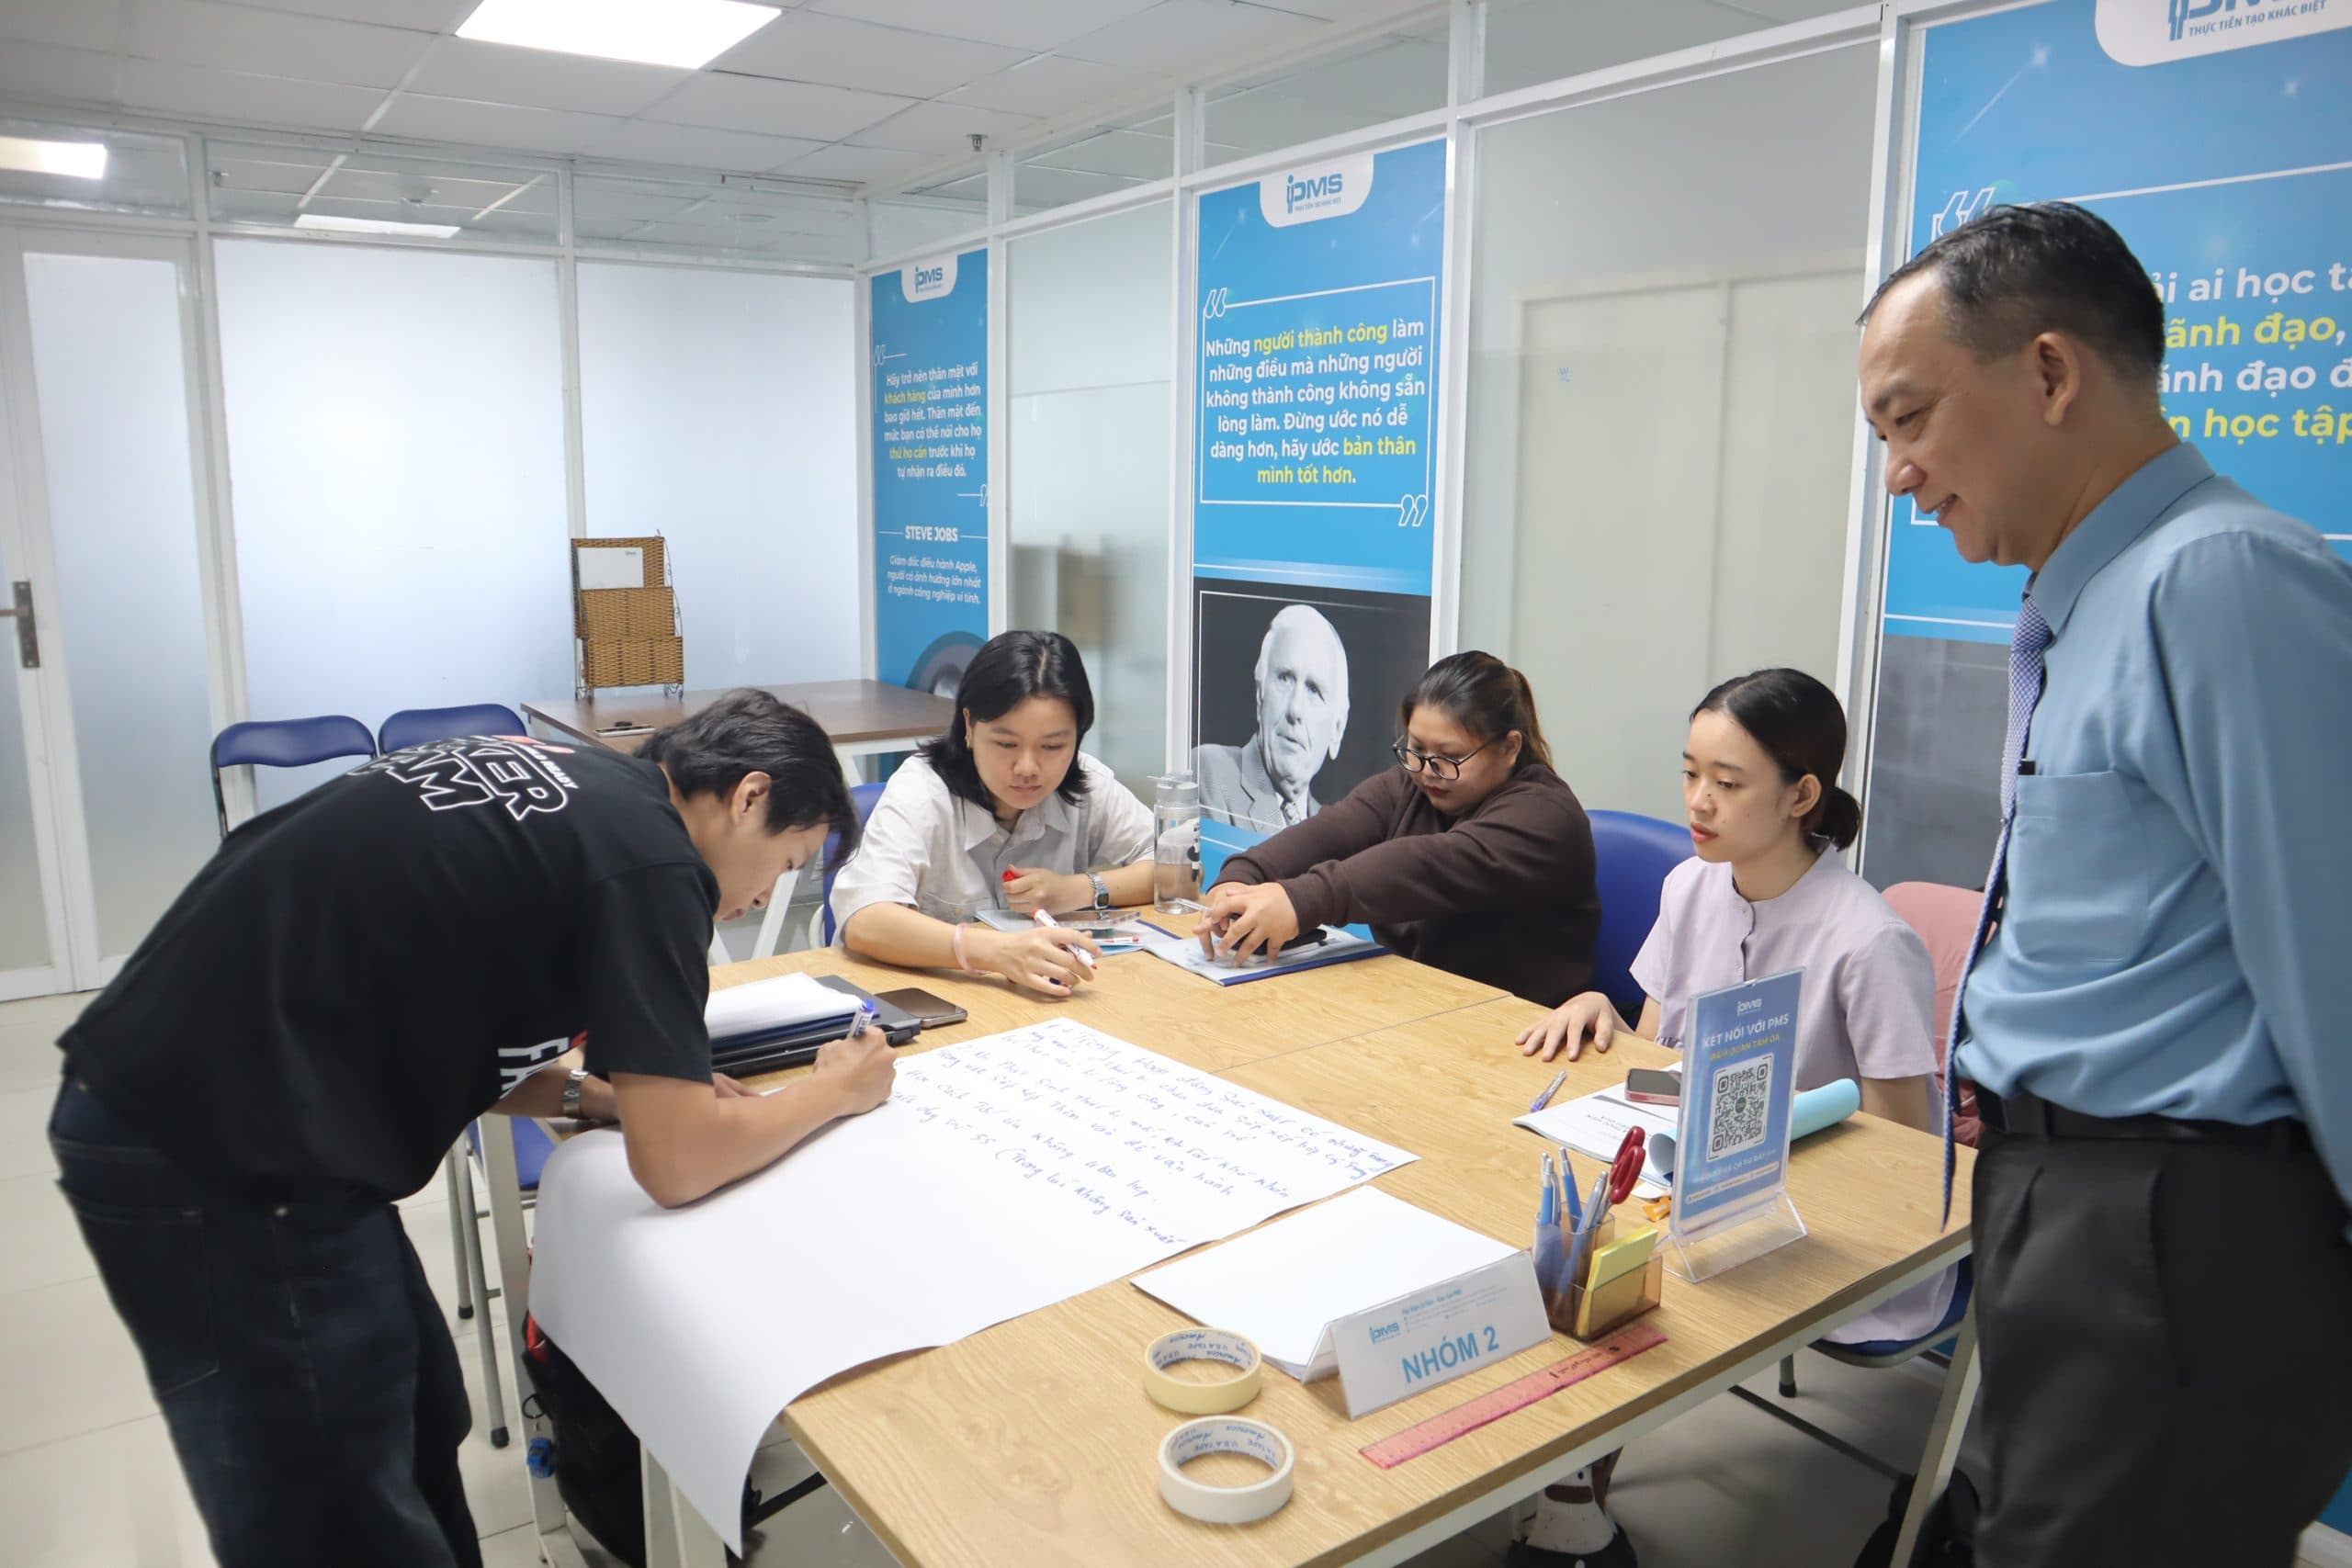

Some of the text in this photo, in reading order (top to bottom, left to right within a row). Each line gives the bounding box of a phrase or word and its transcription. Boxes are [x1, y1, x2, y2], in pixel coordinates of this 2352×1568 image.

[2189, 22, 2216, 37] THỰC
[2220, 15, 2243, 29] TIỄN
[2245, 12, 2265, 26] TẠO
[2268, 5, 2298, 19] KHÁC
[2300, 0, 2326, 14] BIỆT
[2188, 267, 2224, 301] ai
[2236, 267, 2315, 304] học
[1205, 319, 1424, 357] Những người thành công làm
[2165, 312, 2346, 350] ãnh đạo,
[1210, 345, 1422, 383] những điều mà những người
[2236, 360, 2316, 399] đạo
[1206, 373, 1425, 410] không thành công không sẵn
[955, 424, 969, 437] cho
[971, 423, 981, 440] họ
[1218, 403, 1408, 435] lòng làm. Đừng ước nó dễ
[2204, 408, 2279, 445] học
[950, 443, 963, 457] khi
[965, 443, 975, 460] họ
[1211, 434, 1417, 461] dàng hơn, hãy ước bản thân
[926, 468, 933, 478] ra
[1257, 463, 1356, 483] mình tốt hơn.
[905, 525, 958, 542] STEVE JOBS
[1768, 1013, 1789, 1029] PMS
[1401, 1325, 1499, 1383] NHÓM 2
